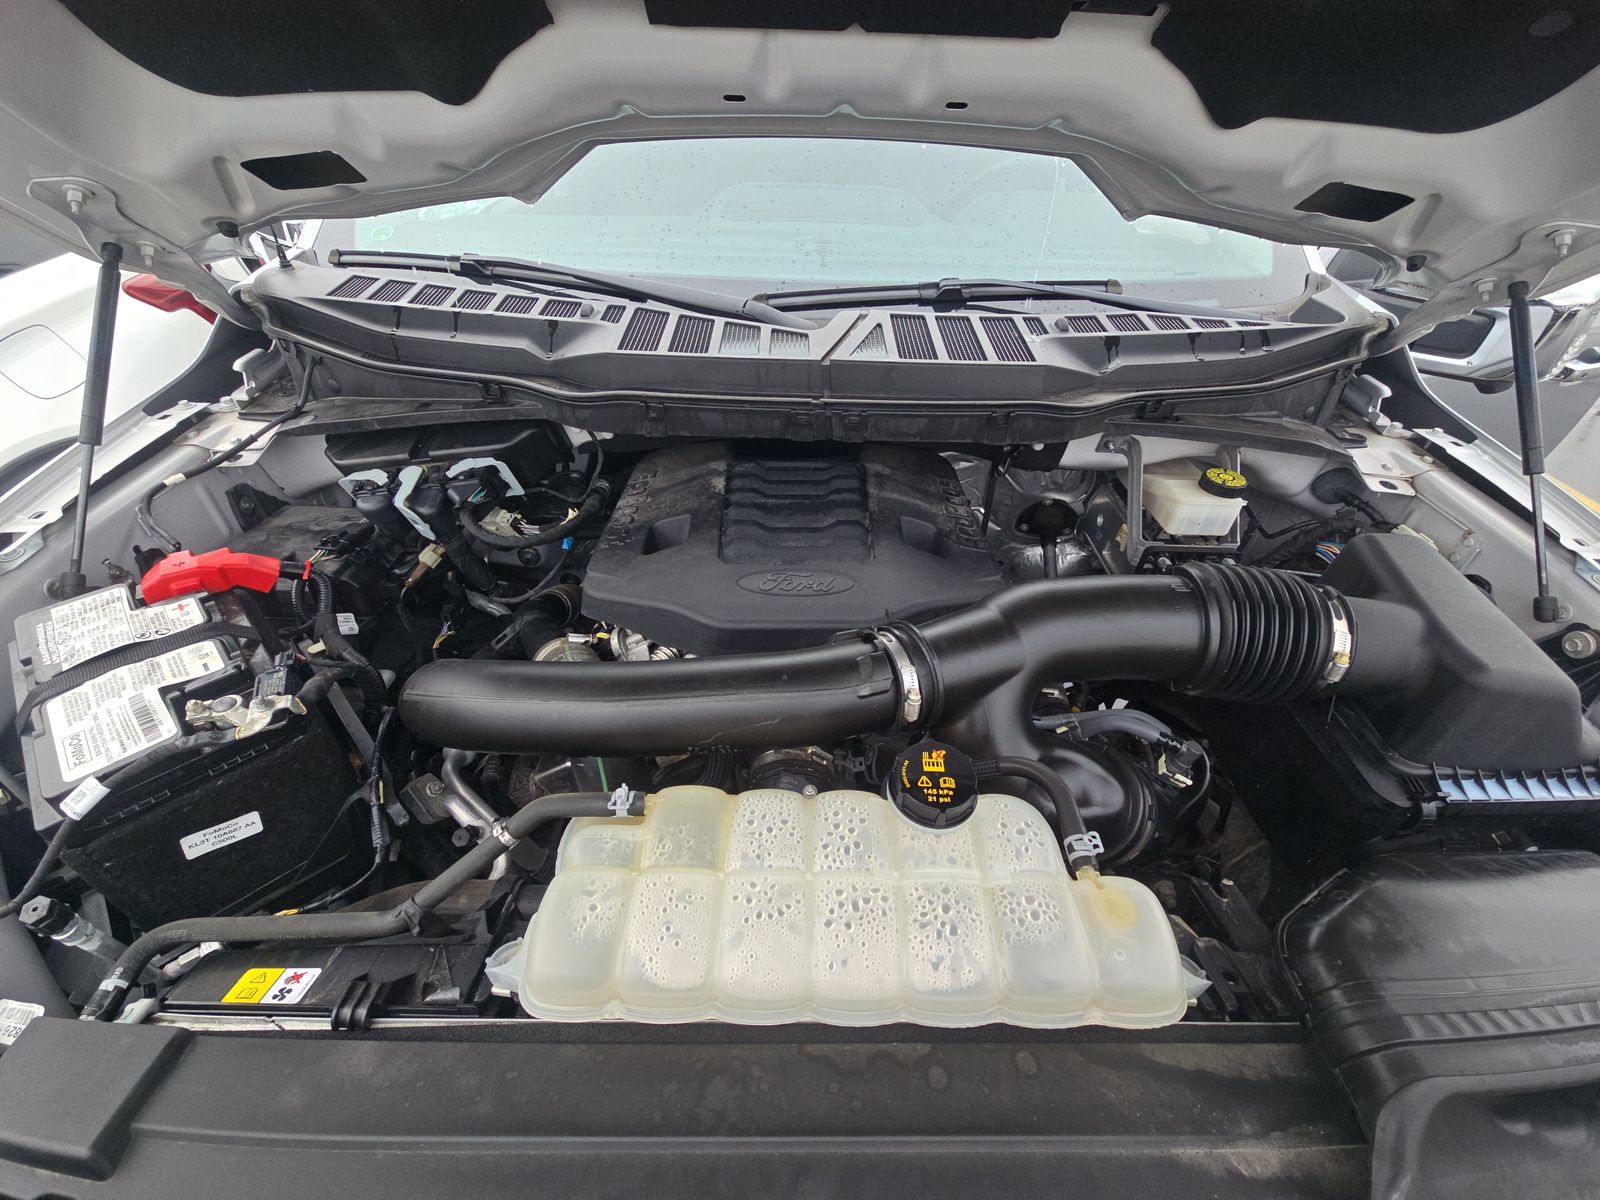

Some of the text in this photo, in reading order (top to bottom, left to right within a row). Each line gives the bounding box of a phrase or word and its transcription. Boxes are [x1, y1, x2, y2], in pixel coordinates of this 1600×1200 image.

[759, 571, 836, 592] Ford
[71, 734, 87, 767] FoMoCo
[202, 822, 239, 837] FoMoCo
[188, 838, 210, 849] KL3T
[211, 835, 238, 846] C500L
